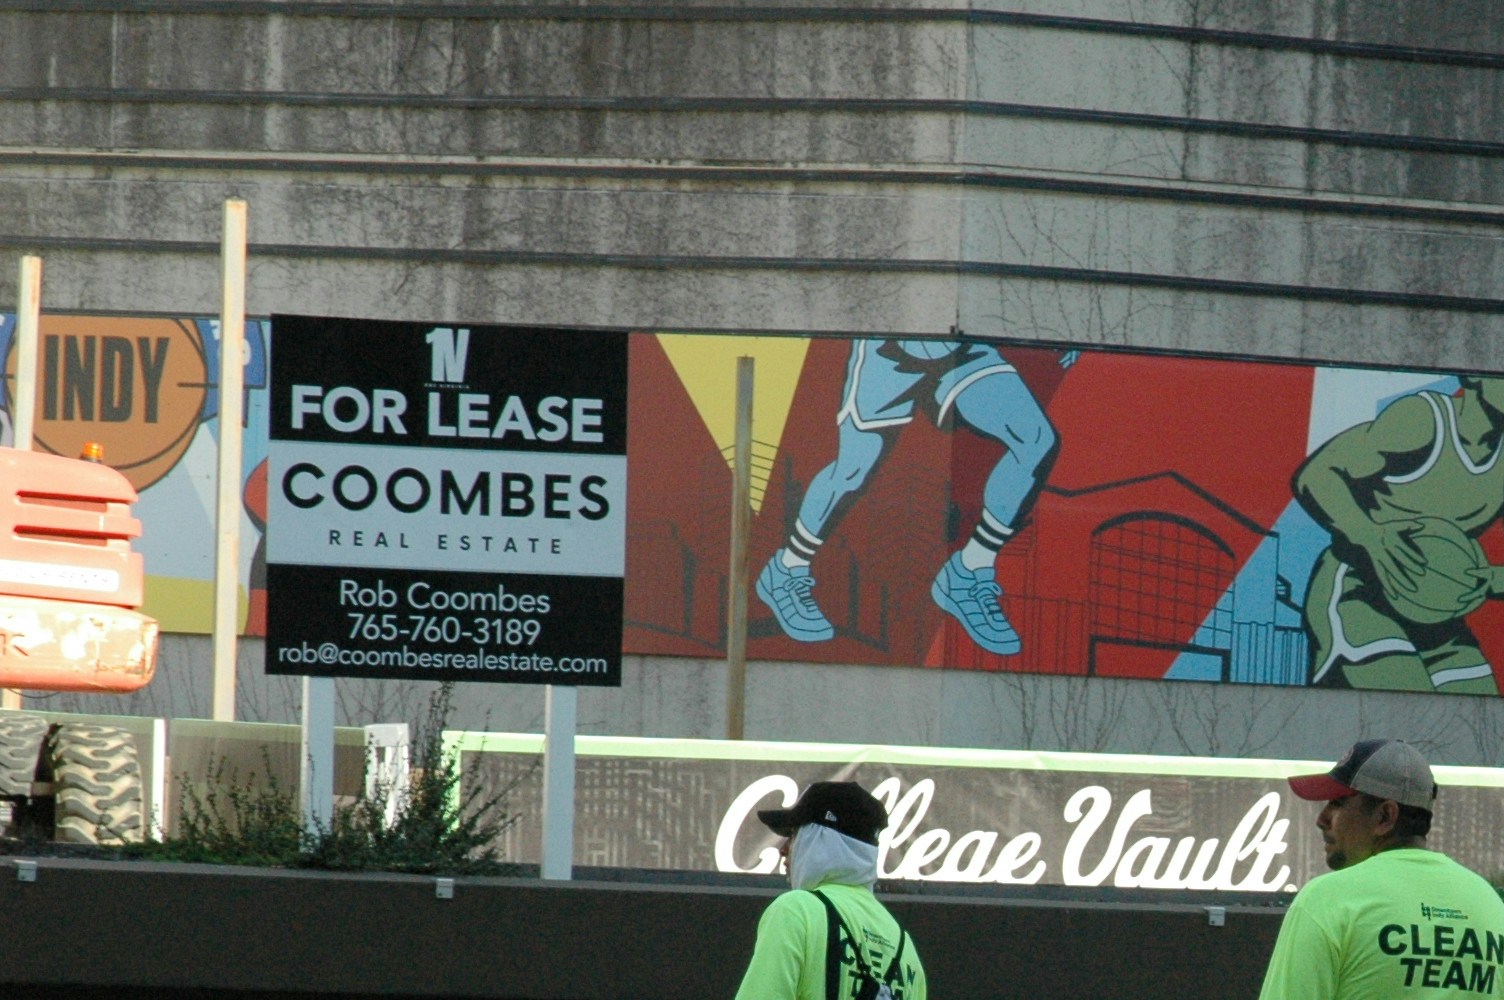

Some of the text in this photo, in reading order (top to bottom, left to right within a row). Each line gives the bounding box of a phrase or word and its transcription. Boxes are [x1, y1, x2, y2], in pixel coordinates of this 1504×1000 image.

[42, 333, 171, 424] INDY
[291, 384, 604, 443] FOR LEASE
[282, 462, 610, 521] COOMBES
[329, 529, 561, 555] REAL ESTATE
[339, 579, 551, 614] Rob Coombes
[348, 613, 541, 646] 765-760-3189
[279, 642, 608, 674] rob@coombesrealestate.com
[714, 774, 1290, 892] Clege Vault
[1400, 957, 1497, 995] TEAM
